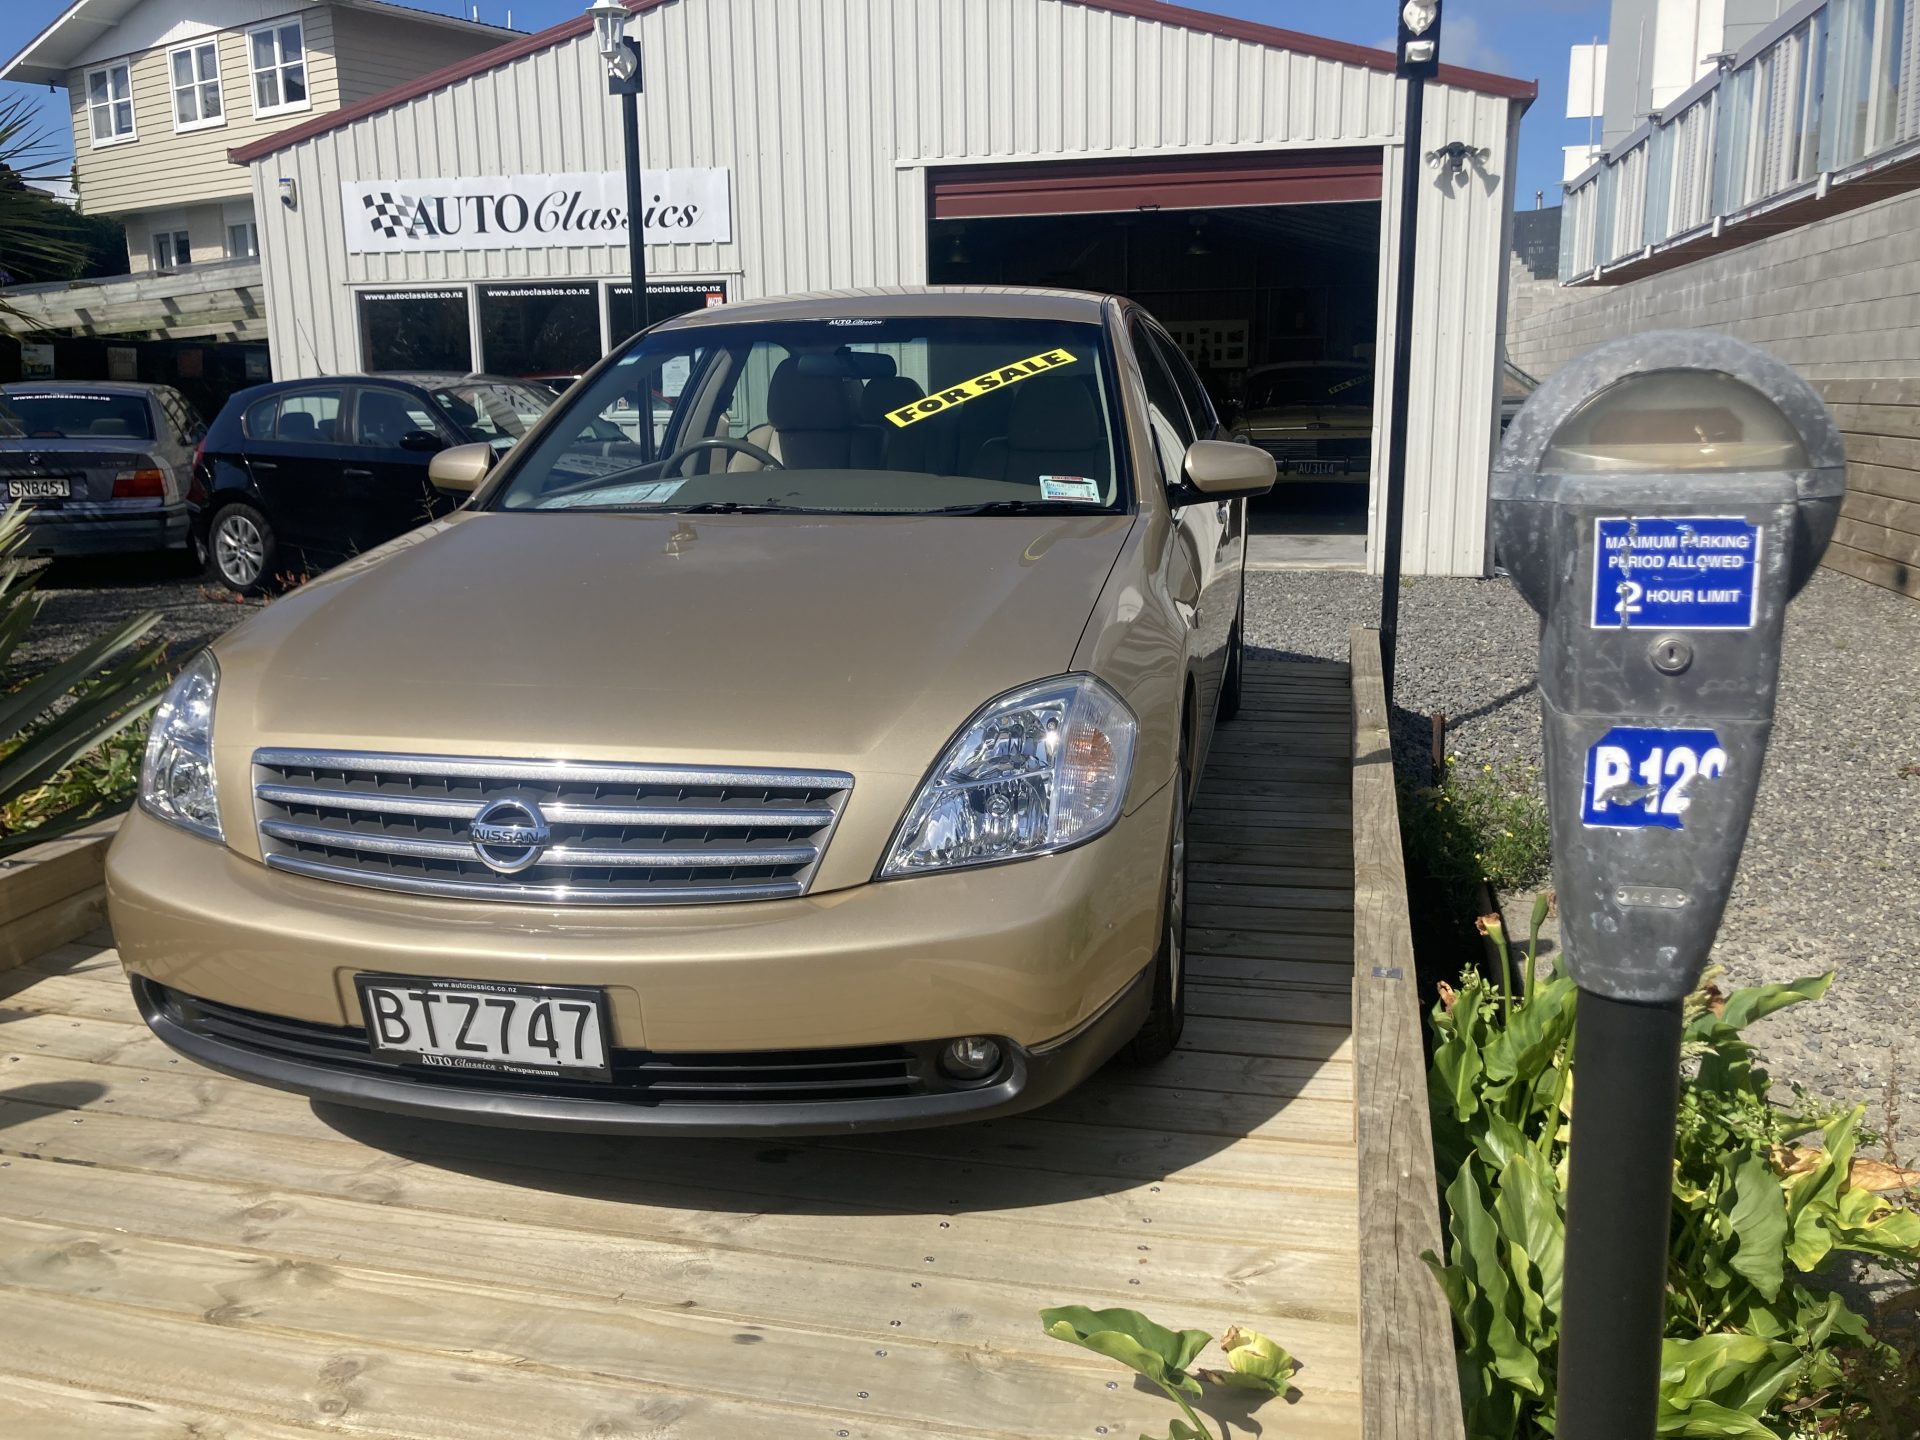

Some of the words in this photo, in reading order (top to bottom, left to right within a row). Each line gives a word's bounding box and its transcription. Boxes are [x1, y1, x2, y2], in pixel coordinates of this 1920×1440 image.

[407, 193, 529, 236] AUTO
[364, 290, 463, 300] www.autoclassics.co.nz
[487, 288, 590, 297] www.autoclassics.co.nz
[895, 388, 973, 423] FOR
[975, 351, 1068, 391] SALE
[11, 480, 67, 496] SN8451
[1605, 536, 1676, 549] MAXIMUM
[1680, 535, 1749, 548] PARKING
[1667, 555, 1744, 568] ALLOWED
[1614, 581, 1643, 612] 2
[1646, 590, 1693, 603] HOUR
[1697, 590, 1741, 603] LIMIT
[474, 829, 539, 843] NISSAN
[371, 989, 591, 1060] BTZ747
[422, 1054, 452, 1066] AUTO
[454, 1058, 496, 1070] Classics
[503, 1065, 559, 1077] Paraparaumu
